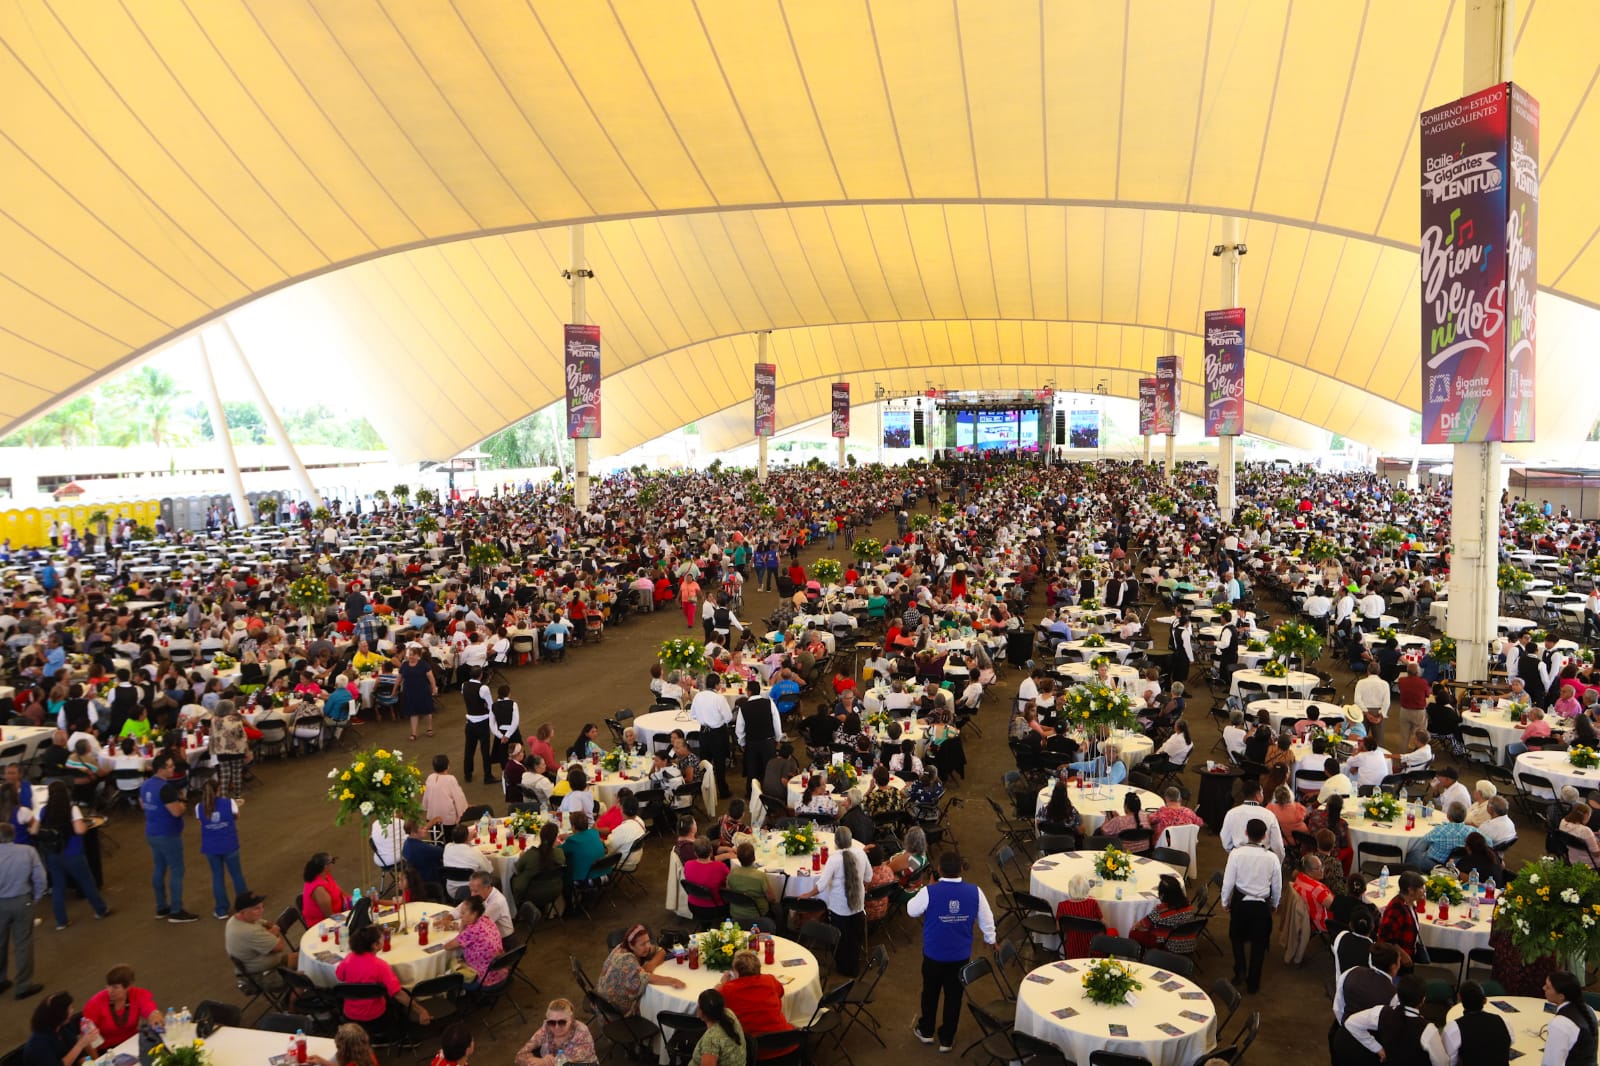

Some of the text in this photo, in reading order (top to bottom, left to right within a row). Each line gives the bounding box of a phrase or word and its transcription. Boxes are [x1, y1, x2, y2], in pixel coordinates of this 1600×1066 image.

[1421, 105, 1463, 127] GOBIERNO
[1470, 91, 1503, 109] ESTADO
[1430, 104, 1498, 135] AGUASCALIENTES
[1426, 153, 1454, 172] Baile
[1434, 156, 1482, 184] Gigantes
[1456, 376, 1489, 390] gigante
[1461, 388, 1492, 399] México
[1440, 412, 1461, 429] Dif
